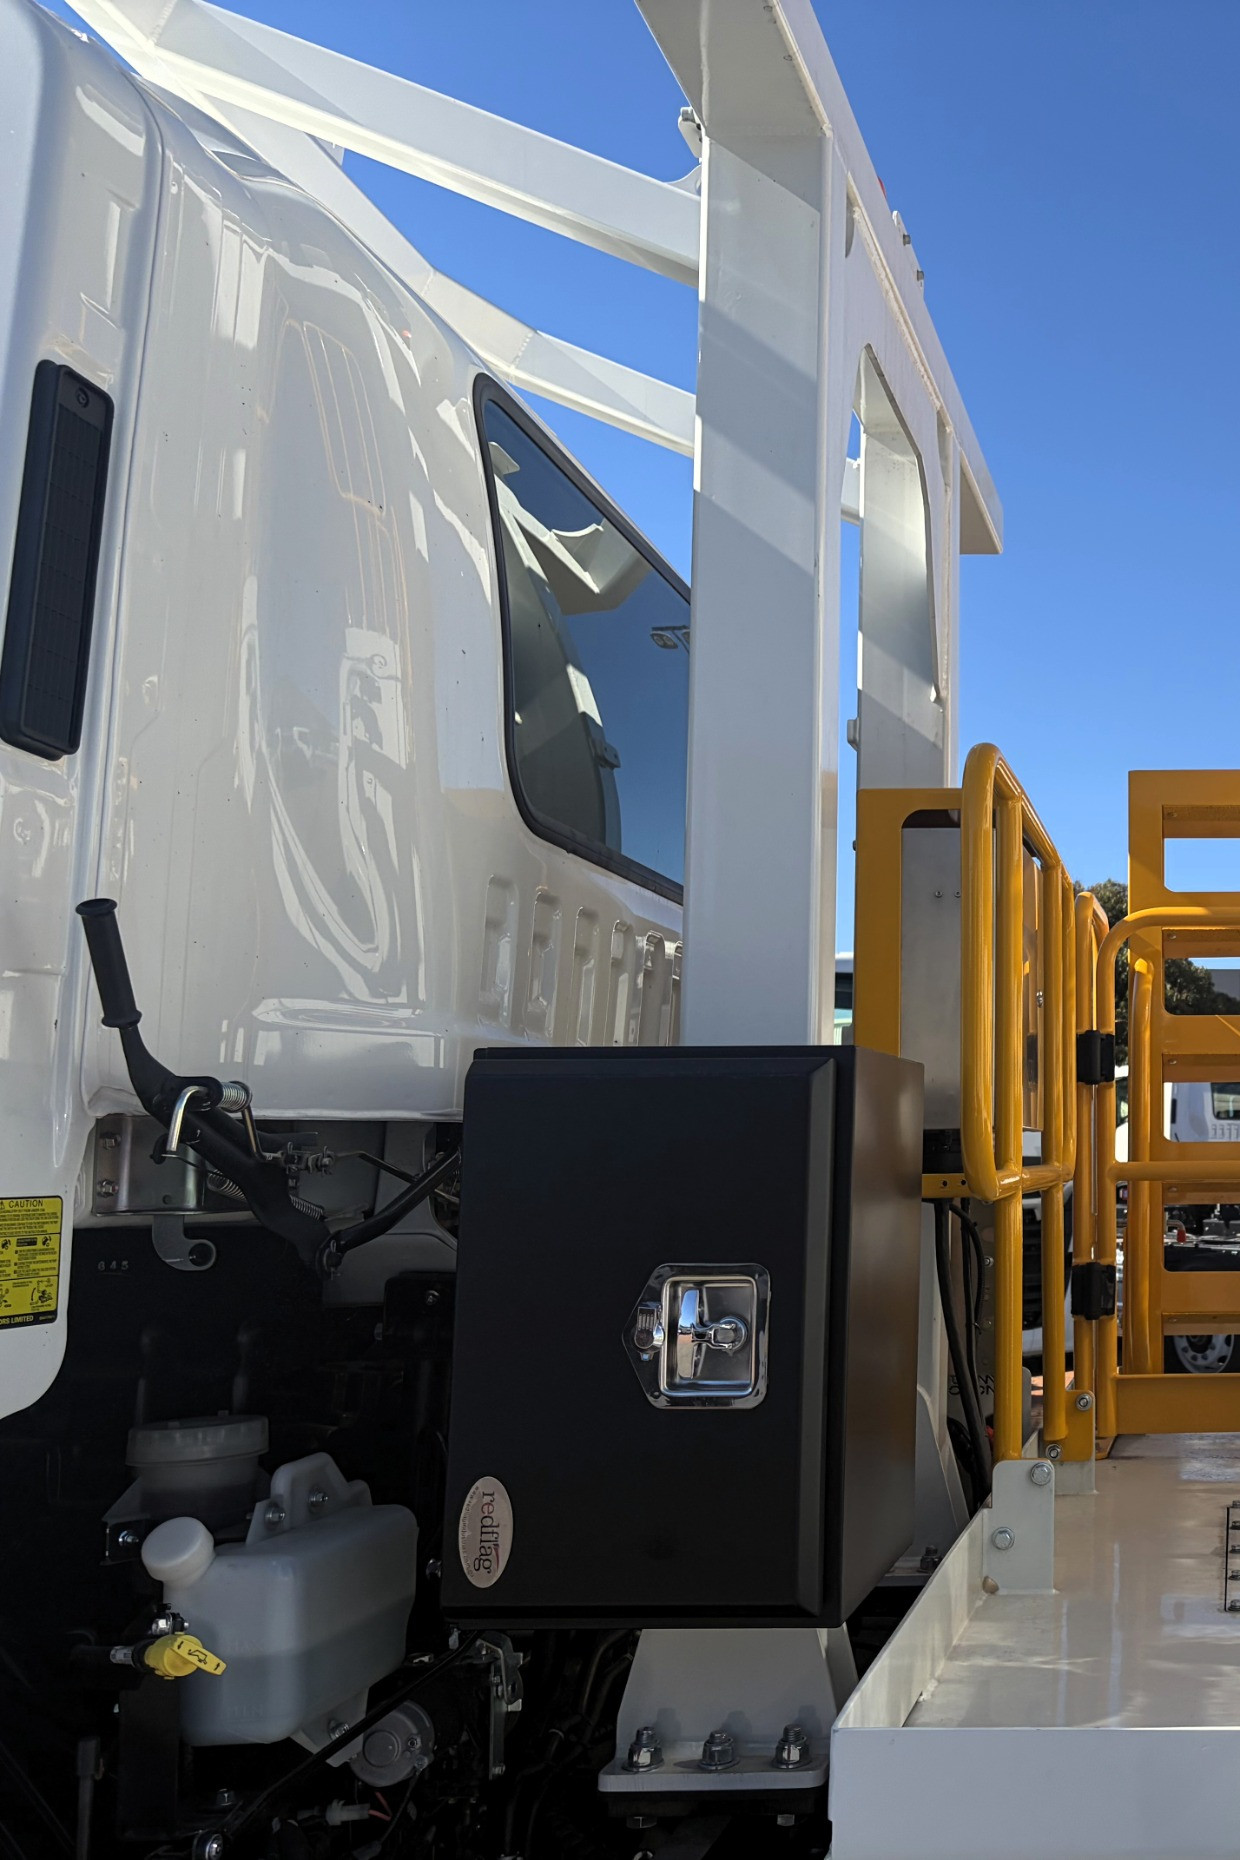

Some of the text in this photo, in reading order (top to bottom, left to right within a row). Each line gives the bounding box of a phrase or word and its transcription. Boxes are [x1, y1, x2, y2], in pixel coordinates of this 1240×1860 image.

[8, 1199, 44, 1208] CAUTION
[11, 1315, 34, 1324] LIMITED
[473, 1491, 500, 1574] redflag
